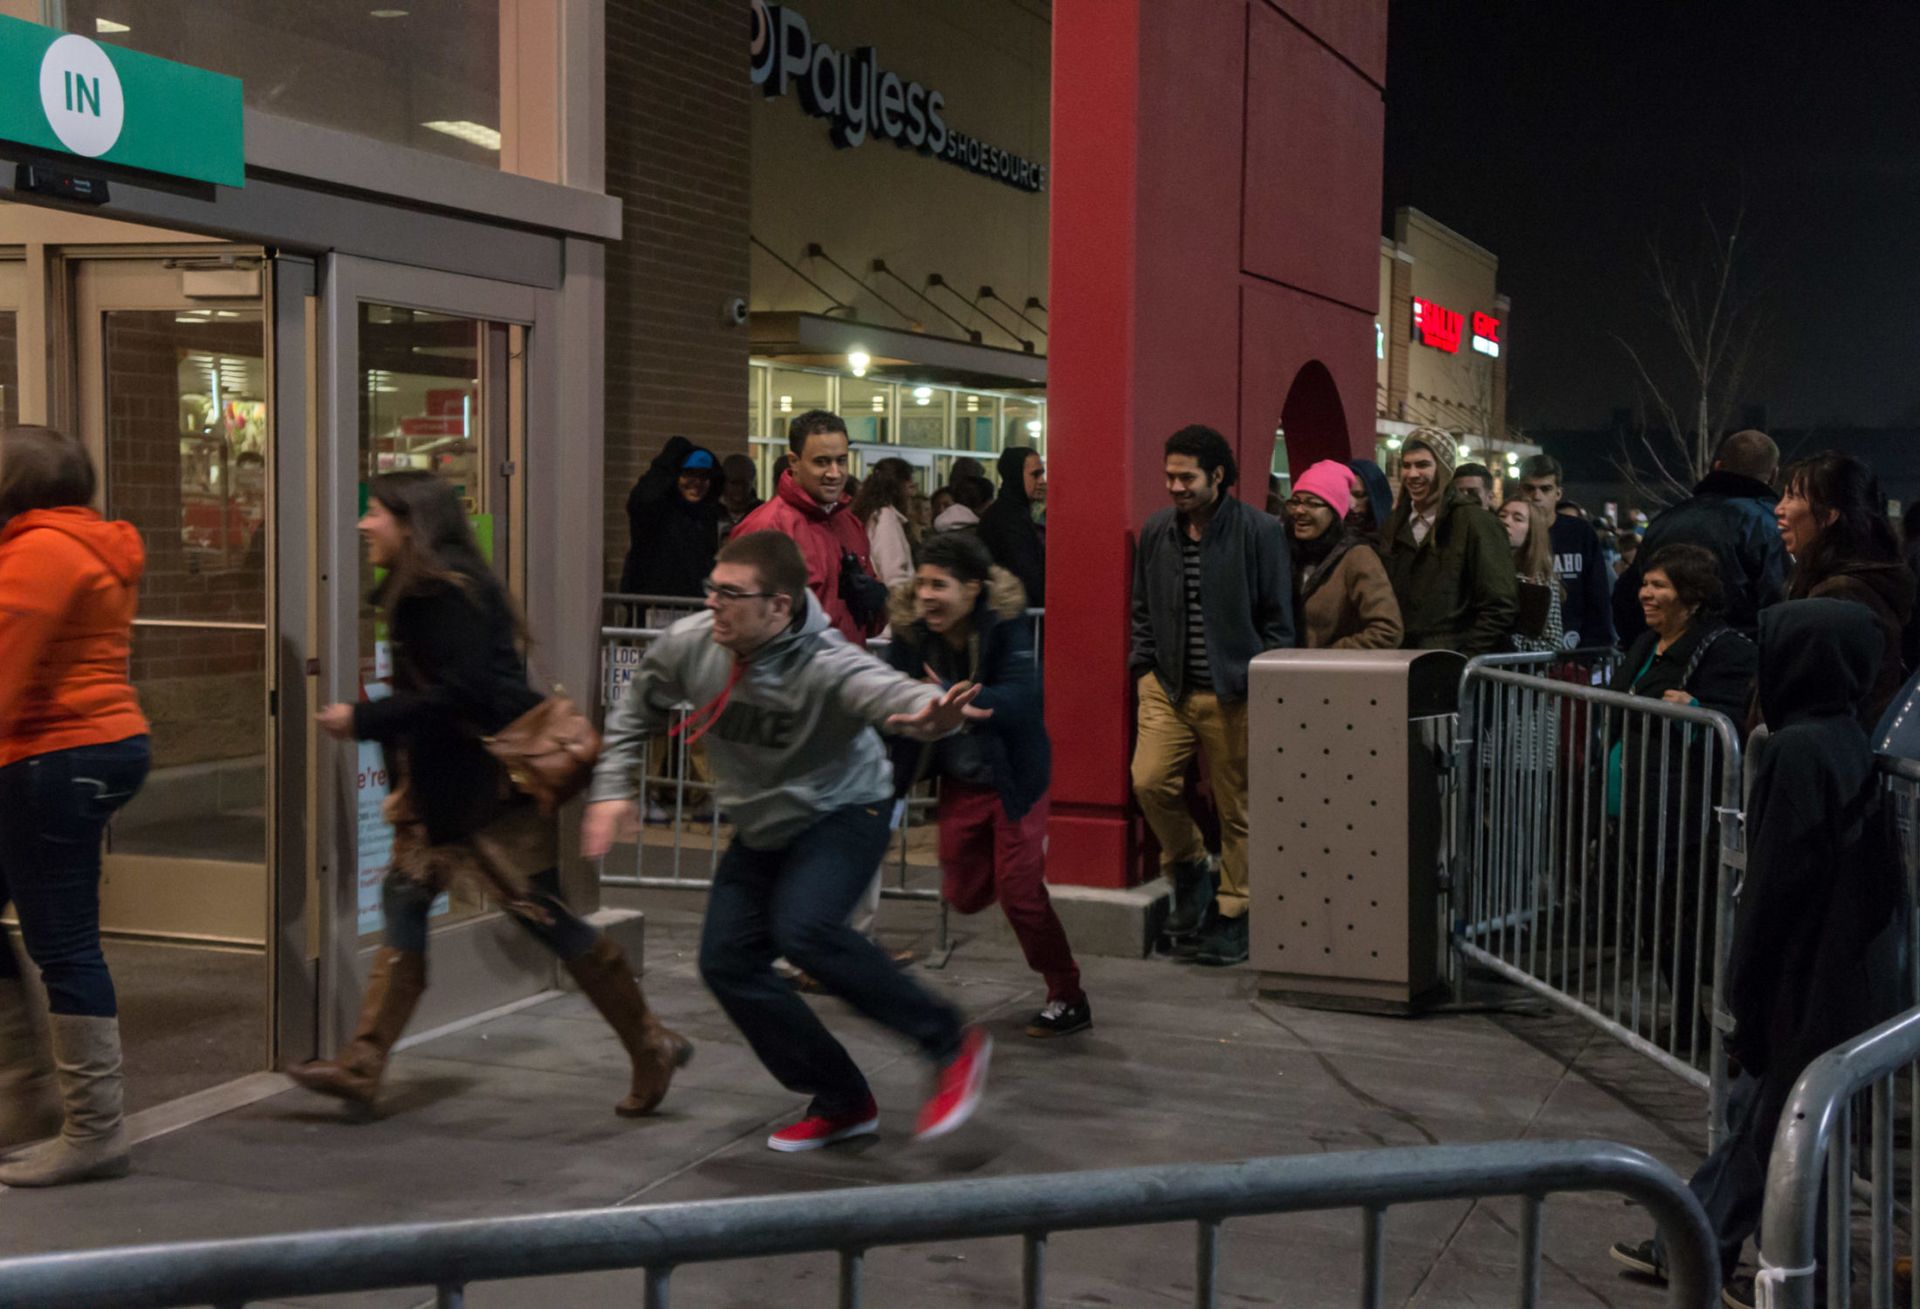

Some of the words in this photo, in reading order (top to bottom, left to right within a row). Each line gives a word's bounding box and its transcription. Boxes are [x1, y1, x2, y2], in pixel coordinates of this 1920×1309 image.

[65, 70, 101, 117] IN
[780, 6, 947, 153] Payless
[947, 130, 1046, 191] SHOESOURCE
